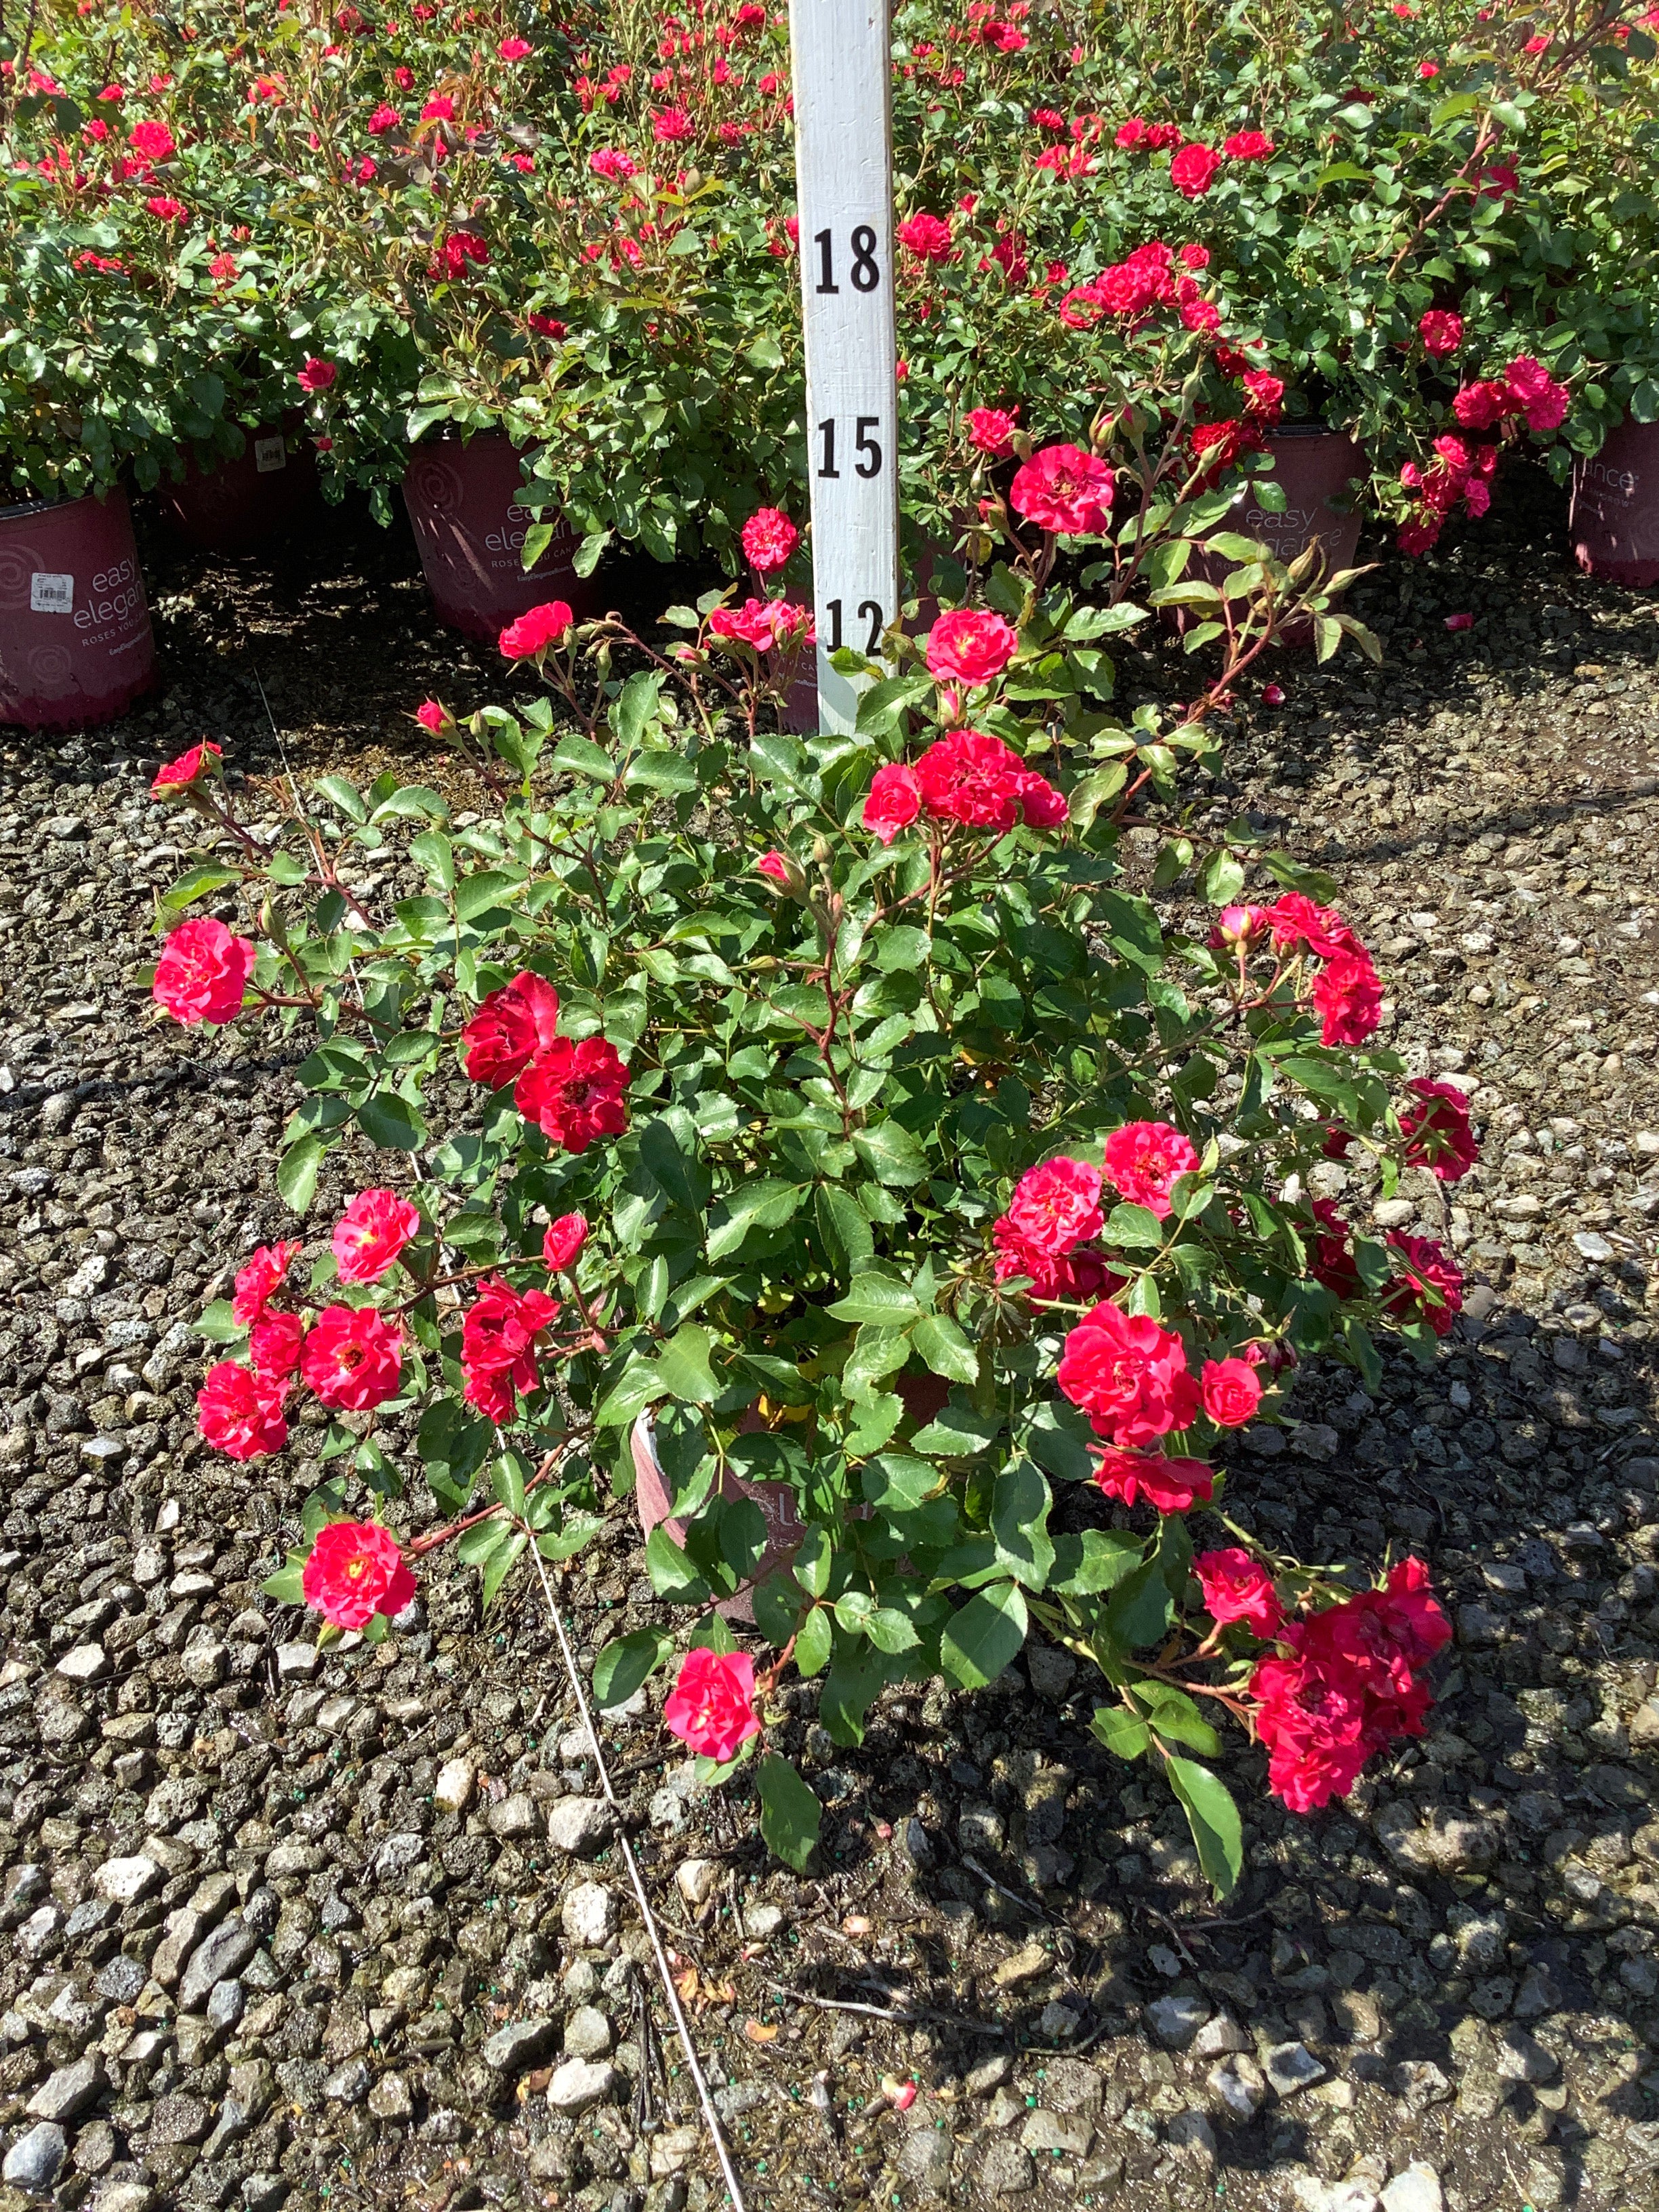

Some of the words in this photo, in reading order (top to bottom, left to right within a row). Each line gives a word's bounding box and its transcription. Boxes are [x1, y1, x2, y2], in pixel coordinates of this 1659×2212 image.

[815, 225, 880, 293] 18
[818, 417, 882, 478] 15
[1246, 508, 1317, 533] easy
[92, 554, 135, 592] easy
[82, 629, 116, 647] ROSES
[826, 599, 882, 657] 12
